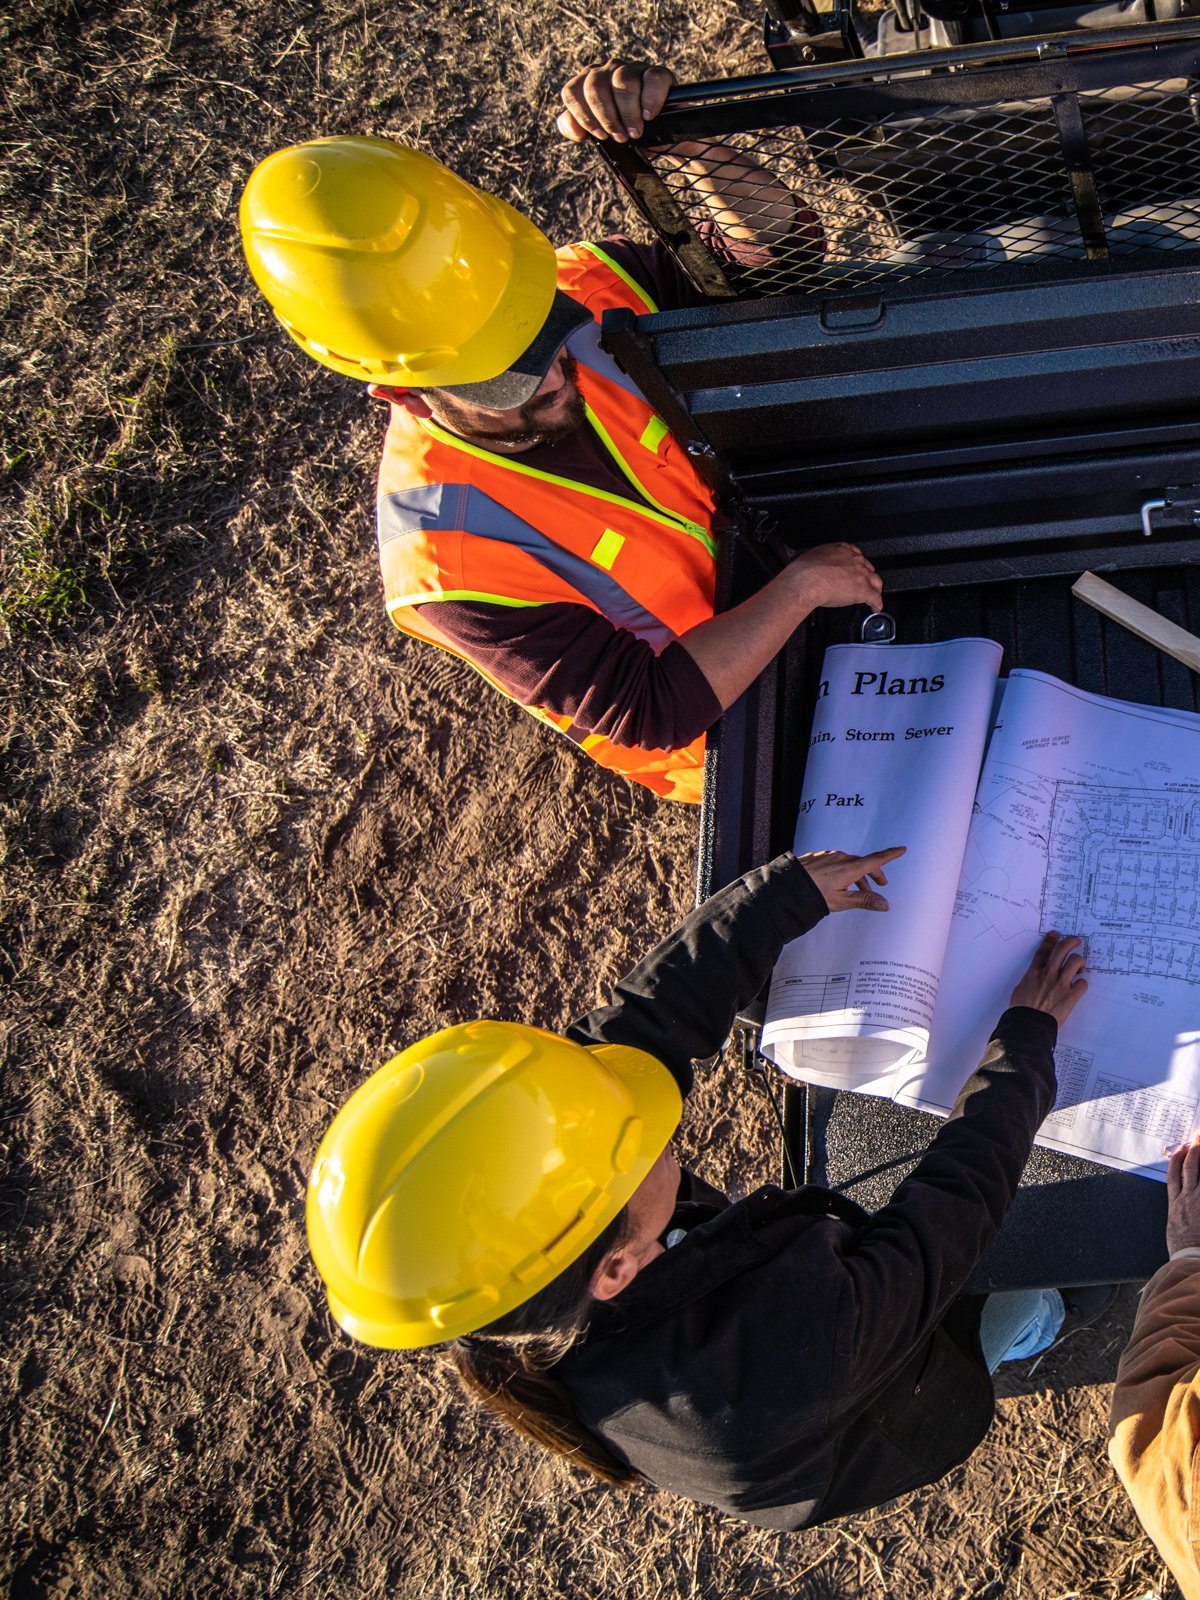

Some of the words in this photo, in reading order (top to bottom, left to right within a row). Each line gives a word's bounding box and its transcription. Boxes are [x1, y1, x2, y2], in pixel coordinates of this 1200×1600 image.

[851, 671, 945, 696] Plans
[845, 729, 895, 741] Storm
[904, 726, 954, 740] Sewer
[824, 793, 865, 807] Park
